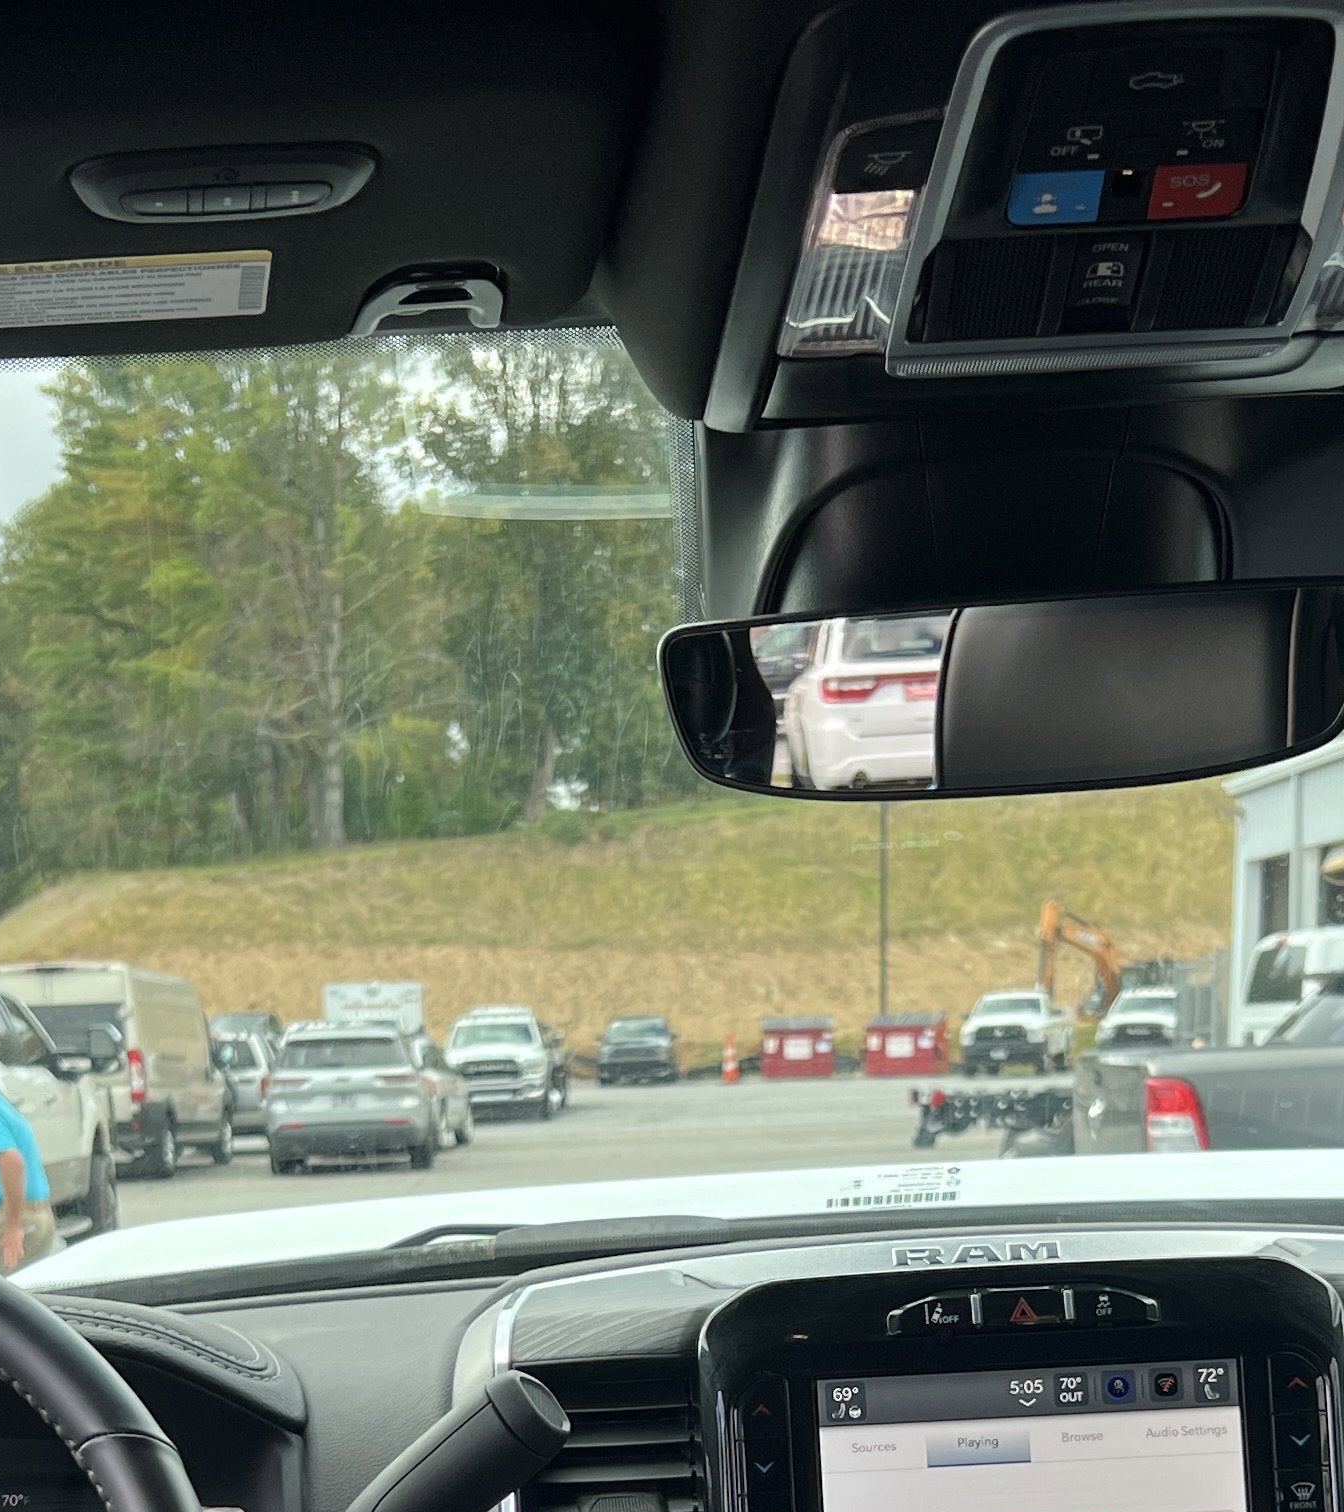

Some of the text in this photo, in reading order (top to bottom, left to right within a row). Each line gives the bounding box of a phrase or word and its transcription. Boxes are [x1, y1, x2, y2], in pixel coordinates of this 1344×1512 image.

[1050, 145, 1080, 157] OFF
[1169, 174, 1211, 189] SOS
[1091, 242, 1129, 254] OPEN
[891, 1240, 1062, 1267] RAM
[1095, 1306, 1114, 1317] OFF
[942, 1313, 960, 1325] OFF
[1009, 1380, 1044, 1395] 5:05
[1059, 1391, 1084, 1403] OUT
[1061, 1430, 1104, 1443] Browse
[1145, 1423, 1228, 1439] Audio Settings
[851, 1441, 897, 1455] Sources
[957, 1435, 999, 1451] Playing
